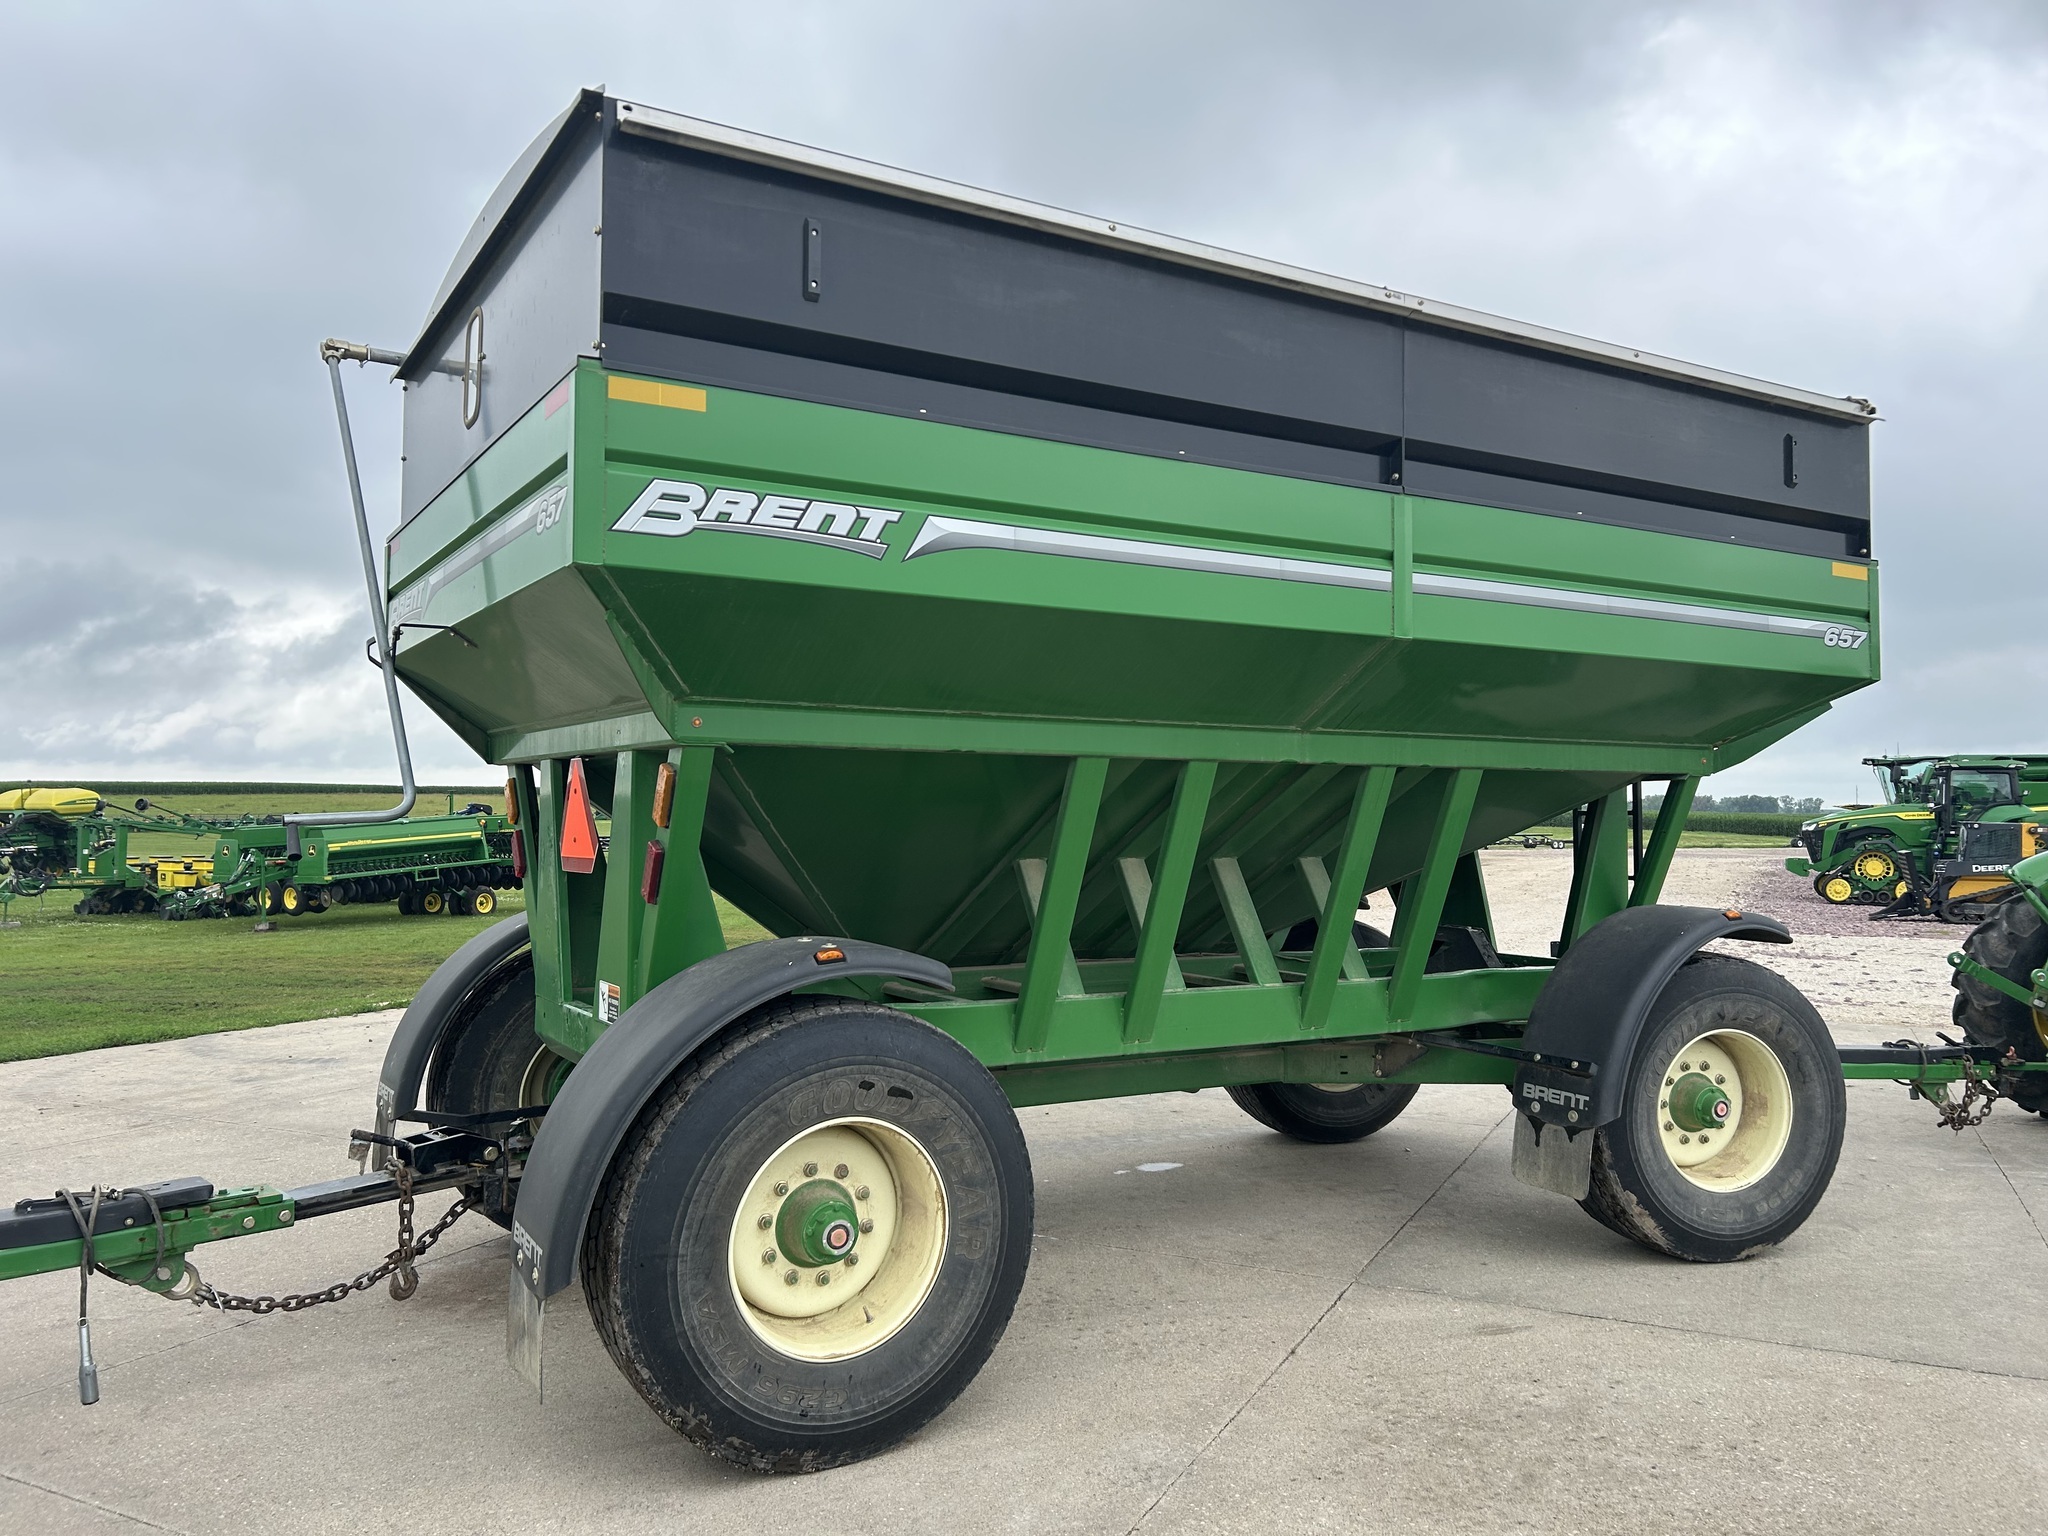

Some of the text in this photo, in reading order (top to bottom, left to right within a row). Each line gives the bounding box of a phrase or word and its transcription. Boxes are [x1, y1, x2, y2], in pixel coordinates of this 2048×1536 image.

[535, 484, 568, 535] 657
[608, 477, 904, 547] BRENT
[1823, 626, 1869, 650] 657
[1522, 1082, 1590, 1111] BRENT
[789, 1078, 990, 1261] GOODYEAR
[513, 1220, 543, 1270] BRENT
[695, 1291, 849, 1409] G296 MSA
